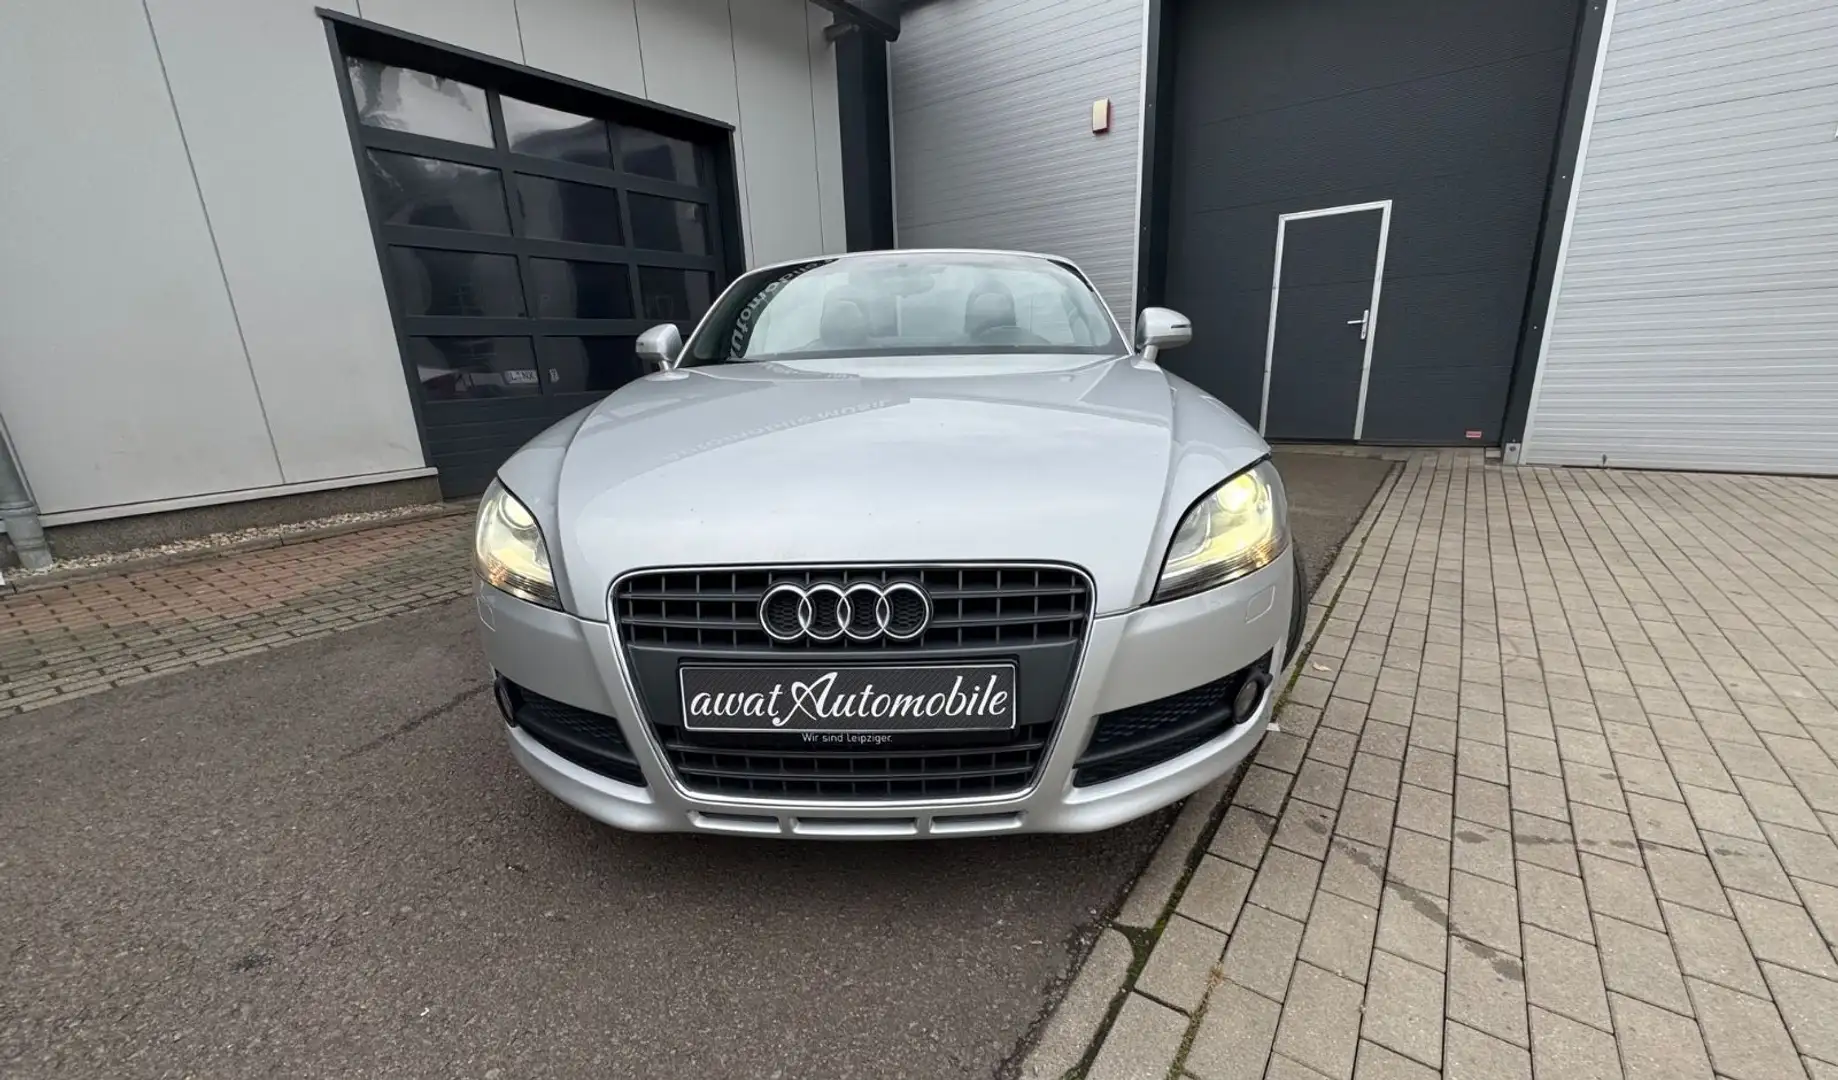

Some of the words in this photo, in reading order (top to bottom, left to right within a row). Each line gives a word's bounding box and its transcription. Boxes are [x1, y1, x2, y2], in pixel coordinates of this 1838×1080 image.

[690, 683, 783, 717] awat
[772, 671, 1008, 727] Automobile
[801, 732, 819, 742] Wir
[822, 732, 844, 742] sind
